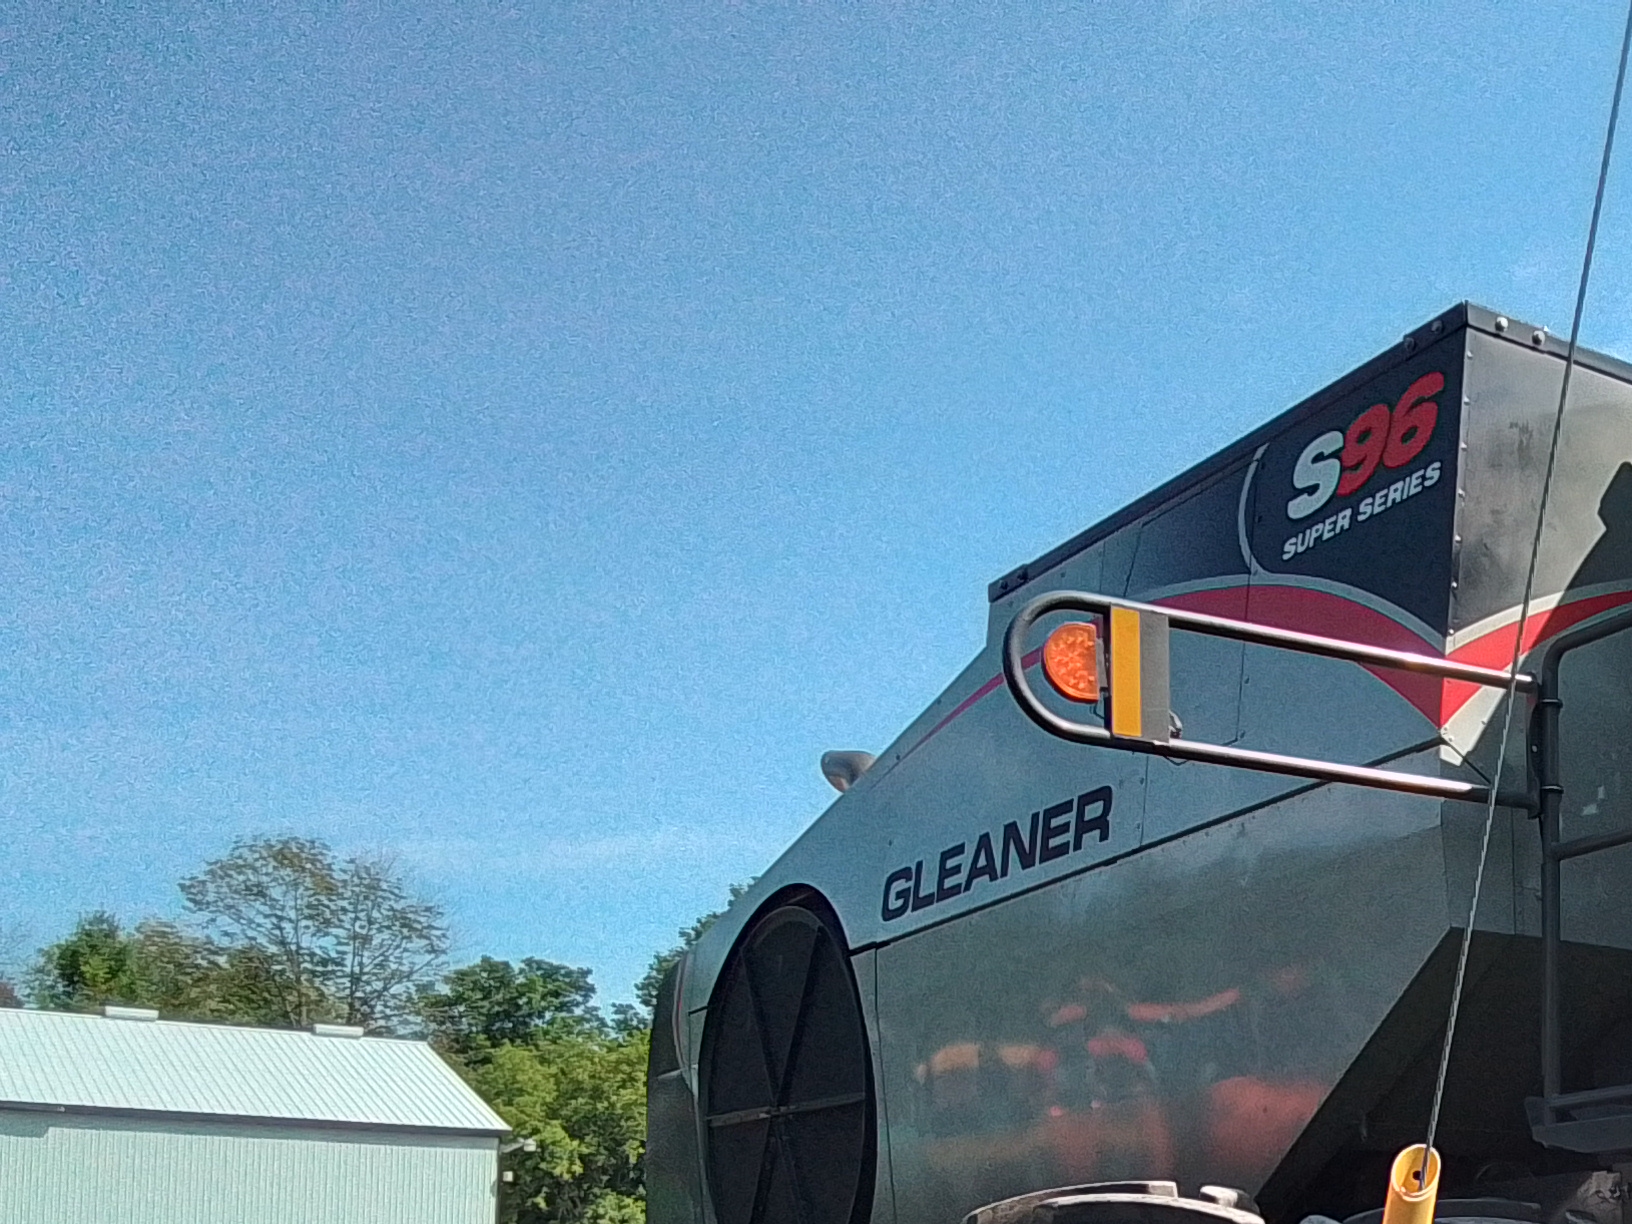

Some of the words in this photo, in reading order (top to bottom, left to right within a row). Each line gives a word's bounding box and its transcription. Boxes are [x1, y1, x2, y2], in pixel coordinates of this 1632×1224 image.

[1282, 509, 1353, 560] SUPER
[1357, 461, 1442, 521] SERIES
[1287, 372, 1445, 520] S96
[881, 784, 1114, 923] GLEANER
